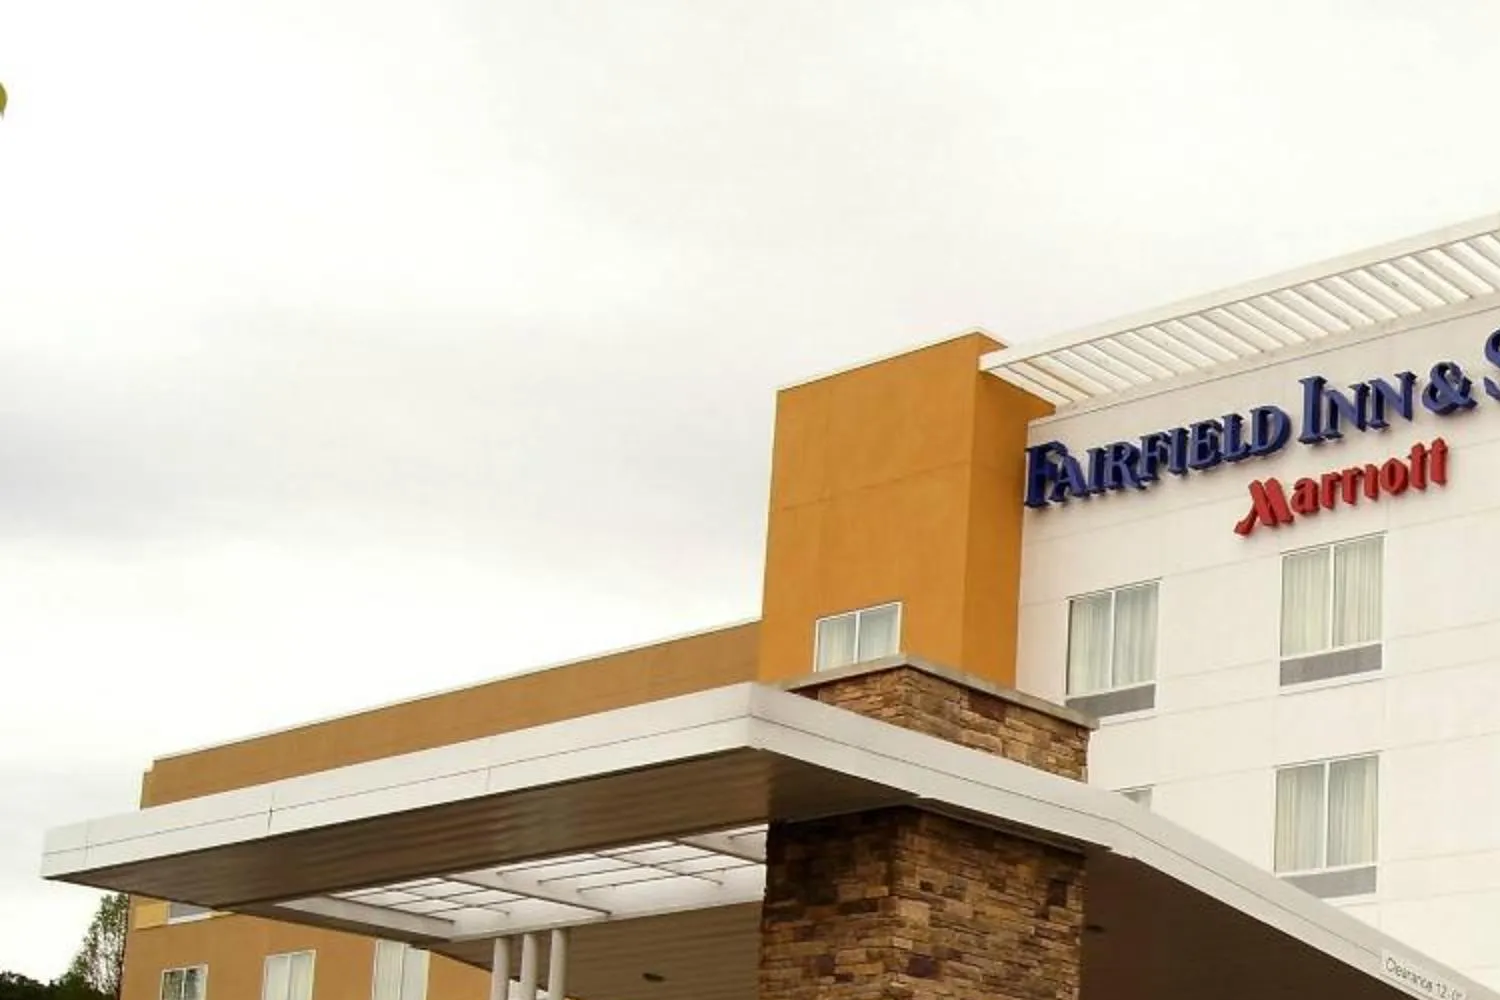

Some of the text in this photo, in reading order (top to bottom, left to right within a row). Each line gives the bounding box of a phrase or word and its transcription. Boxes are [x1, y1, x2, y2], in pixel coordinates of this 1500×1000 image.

[1024, 405, 1292, 508] FAIRFIELD
[1298, 371, 1417, 444] INN
[1234, 437, 1448, 536] Marriott
